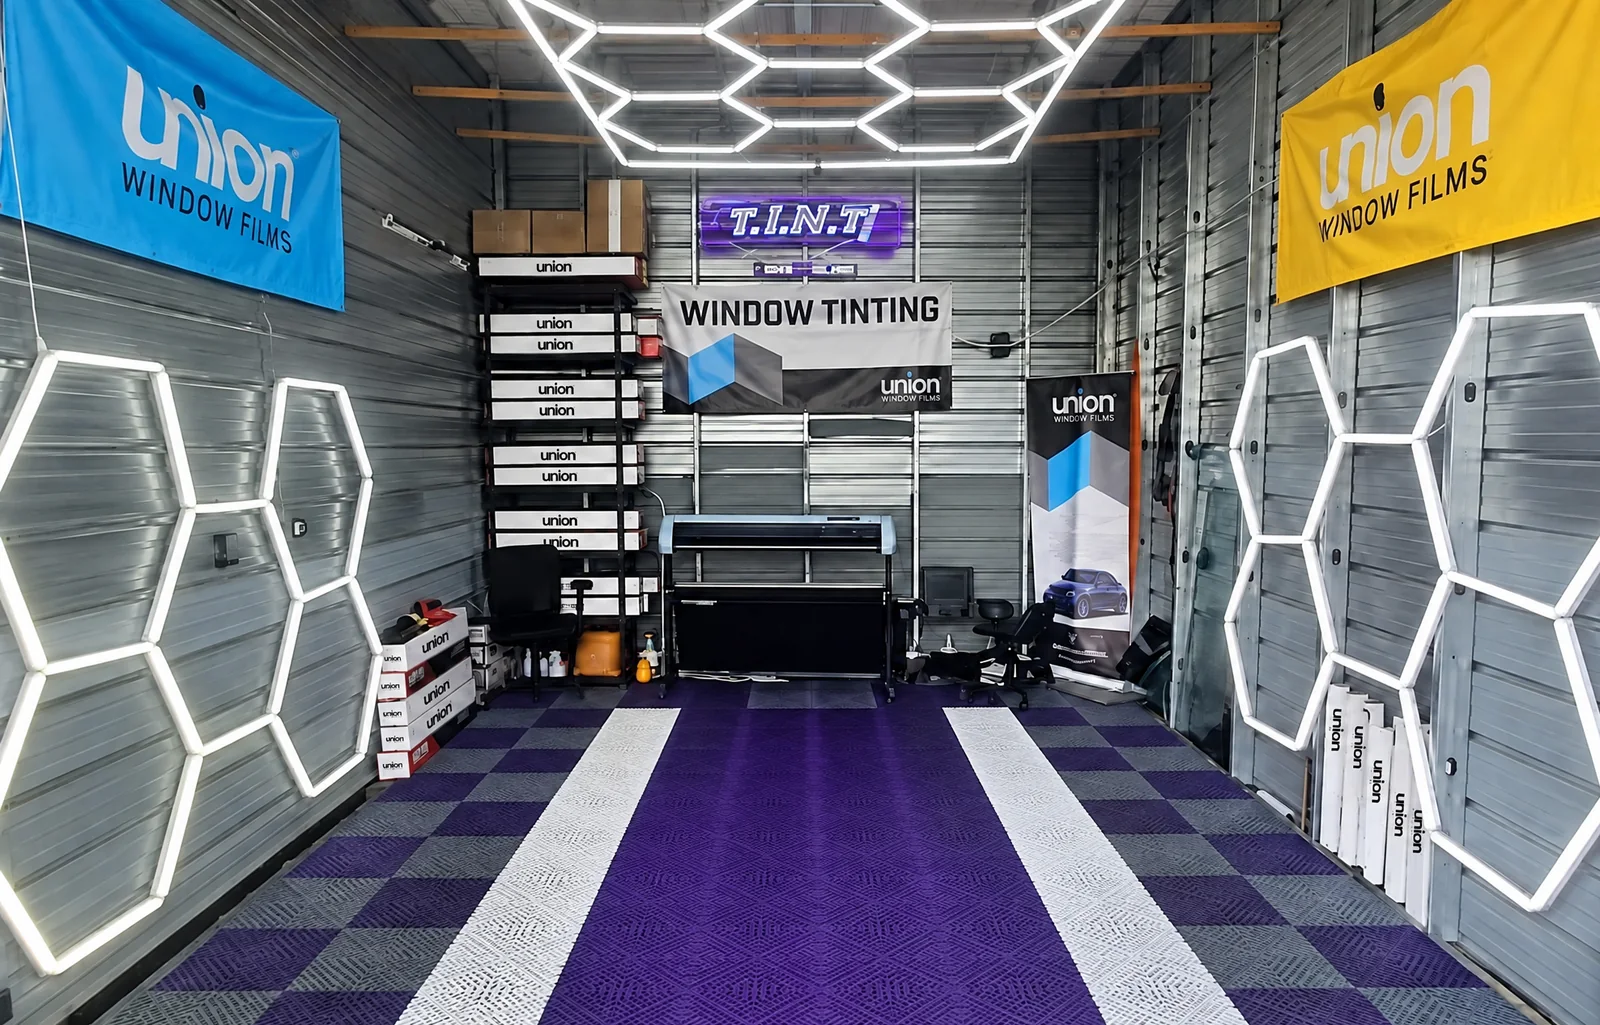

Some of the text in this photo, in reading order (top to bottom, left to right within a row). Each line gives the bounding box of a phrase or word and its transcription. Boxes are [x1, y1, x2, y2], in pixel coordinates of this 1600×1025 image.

[122, 65, 295, 221] union
[1319, 64, 1491, 210] union
[121, 162, 292, 254] WINDOW FILMS
[1318, 154, 1488, 243] WINDOW FILMS
[536, 260, 572, 273] union
[536, 316, 573, 329] union
[680, 296, 939, 326] WINDOW TINTING
[537, 338, 573, 350] union
[538, 382, 575, 395] union
[880, 371, 940, 394] union
[539, 404, 575, 416] union
[881, 394, 941, 403] WINDOW FILMS
[1052, 387, 1115, 415] union
[1053, 414, 1115, 423] WINDOW FILMS
[540, 448, 576, 461] union
[542, 469, 578, 482] union
[542, 514, 578, 526] union
[422, 631, 449, 654] union
[381, 682, 400, 690] union
[423, 679, 451, 705] union
[382, 709, 402, 718] union
[426, 701, 453, 729] union
[385, 735, 405, 743] union
[1331, 708, 1345, 752] union
[1352, 725, 1367, 769] union
[382, 761, 403, 770] union
[1371, 759, 1385, 804] union
[1393, 793, 1408, 837] union
[1412, 809, 1426, 854] union
